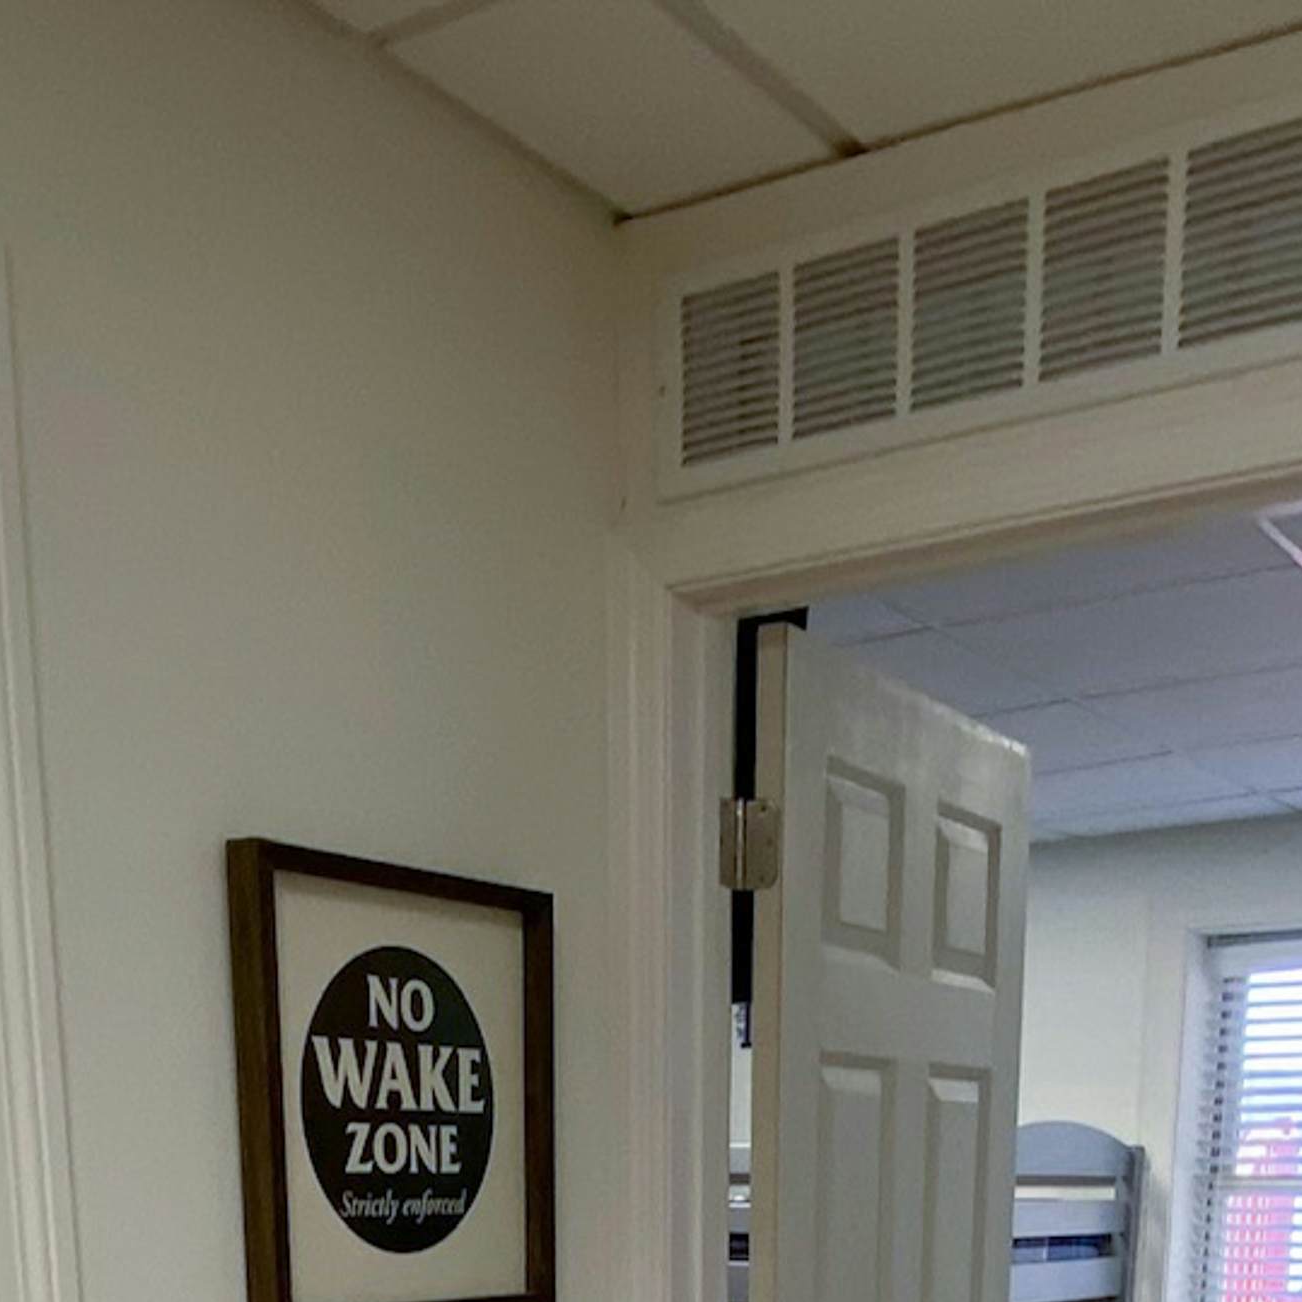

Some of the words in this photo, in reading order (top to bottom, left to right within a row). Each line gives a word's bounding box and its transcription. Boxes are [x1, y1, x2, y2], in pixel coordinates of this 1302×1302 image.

[366, 973, 436, 1033] NO
[310, 1034, 486, 1114] WAKE
[344, 1121, 462, 1175] ZONE
[340, 1186, 399, 1226] Strictly
[401, 1187, 468, 1226] enforced
